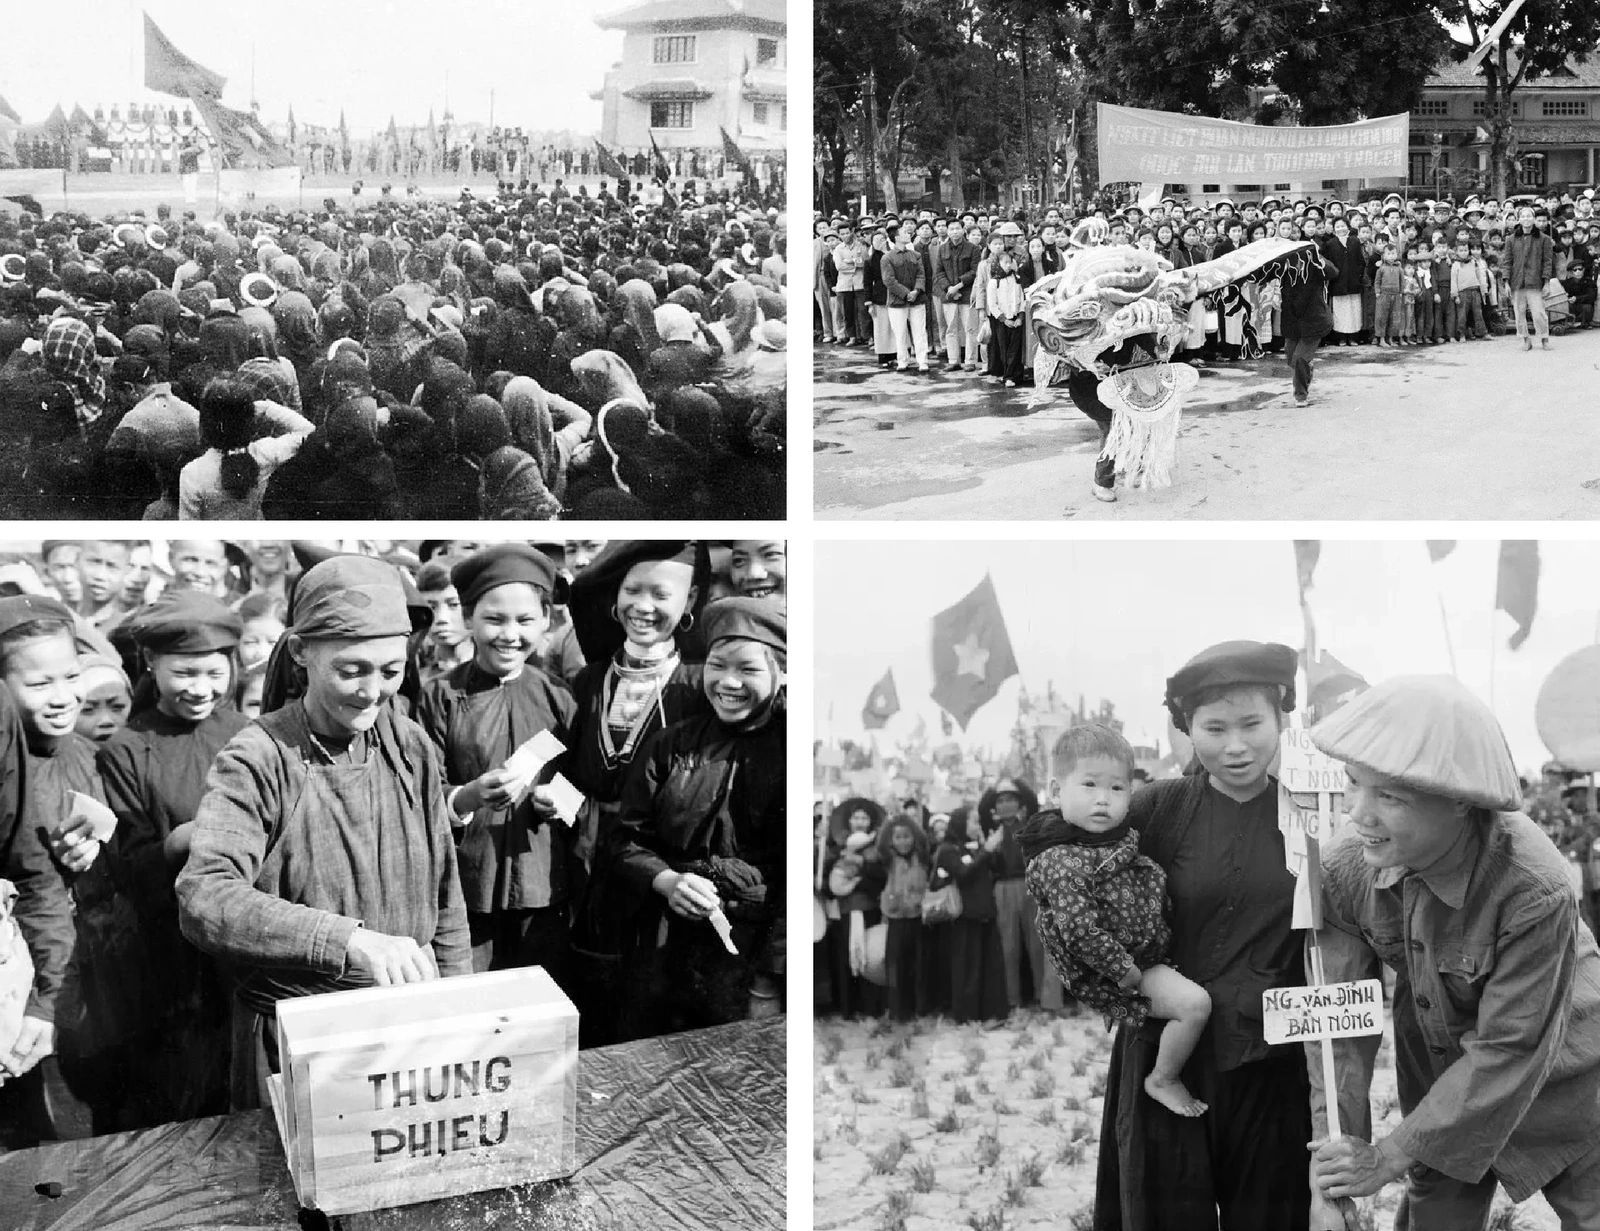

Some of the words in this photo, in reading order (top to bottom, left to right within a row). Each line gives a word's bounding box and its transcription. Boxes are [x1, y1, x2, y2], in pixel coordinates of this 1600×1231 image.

[1328, 1008, 1374, 1032] NÔNG
[367, 1054, 512, 1111] THUNG
[370, 1109, 509, 1163] PHIEU
